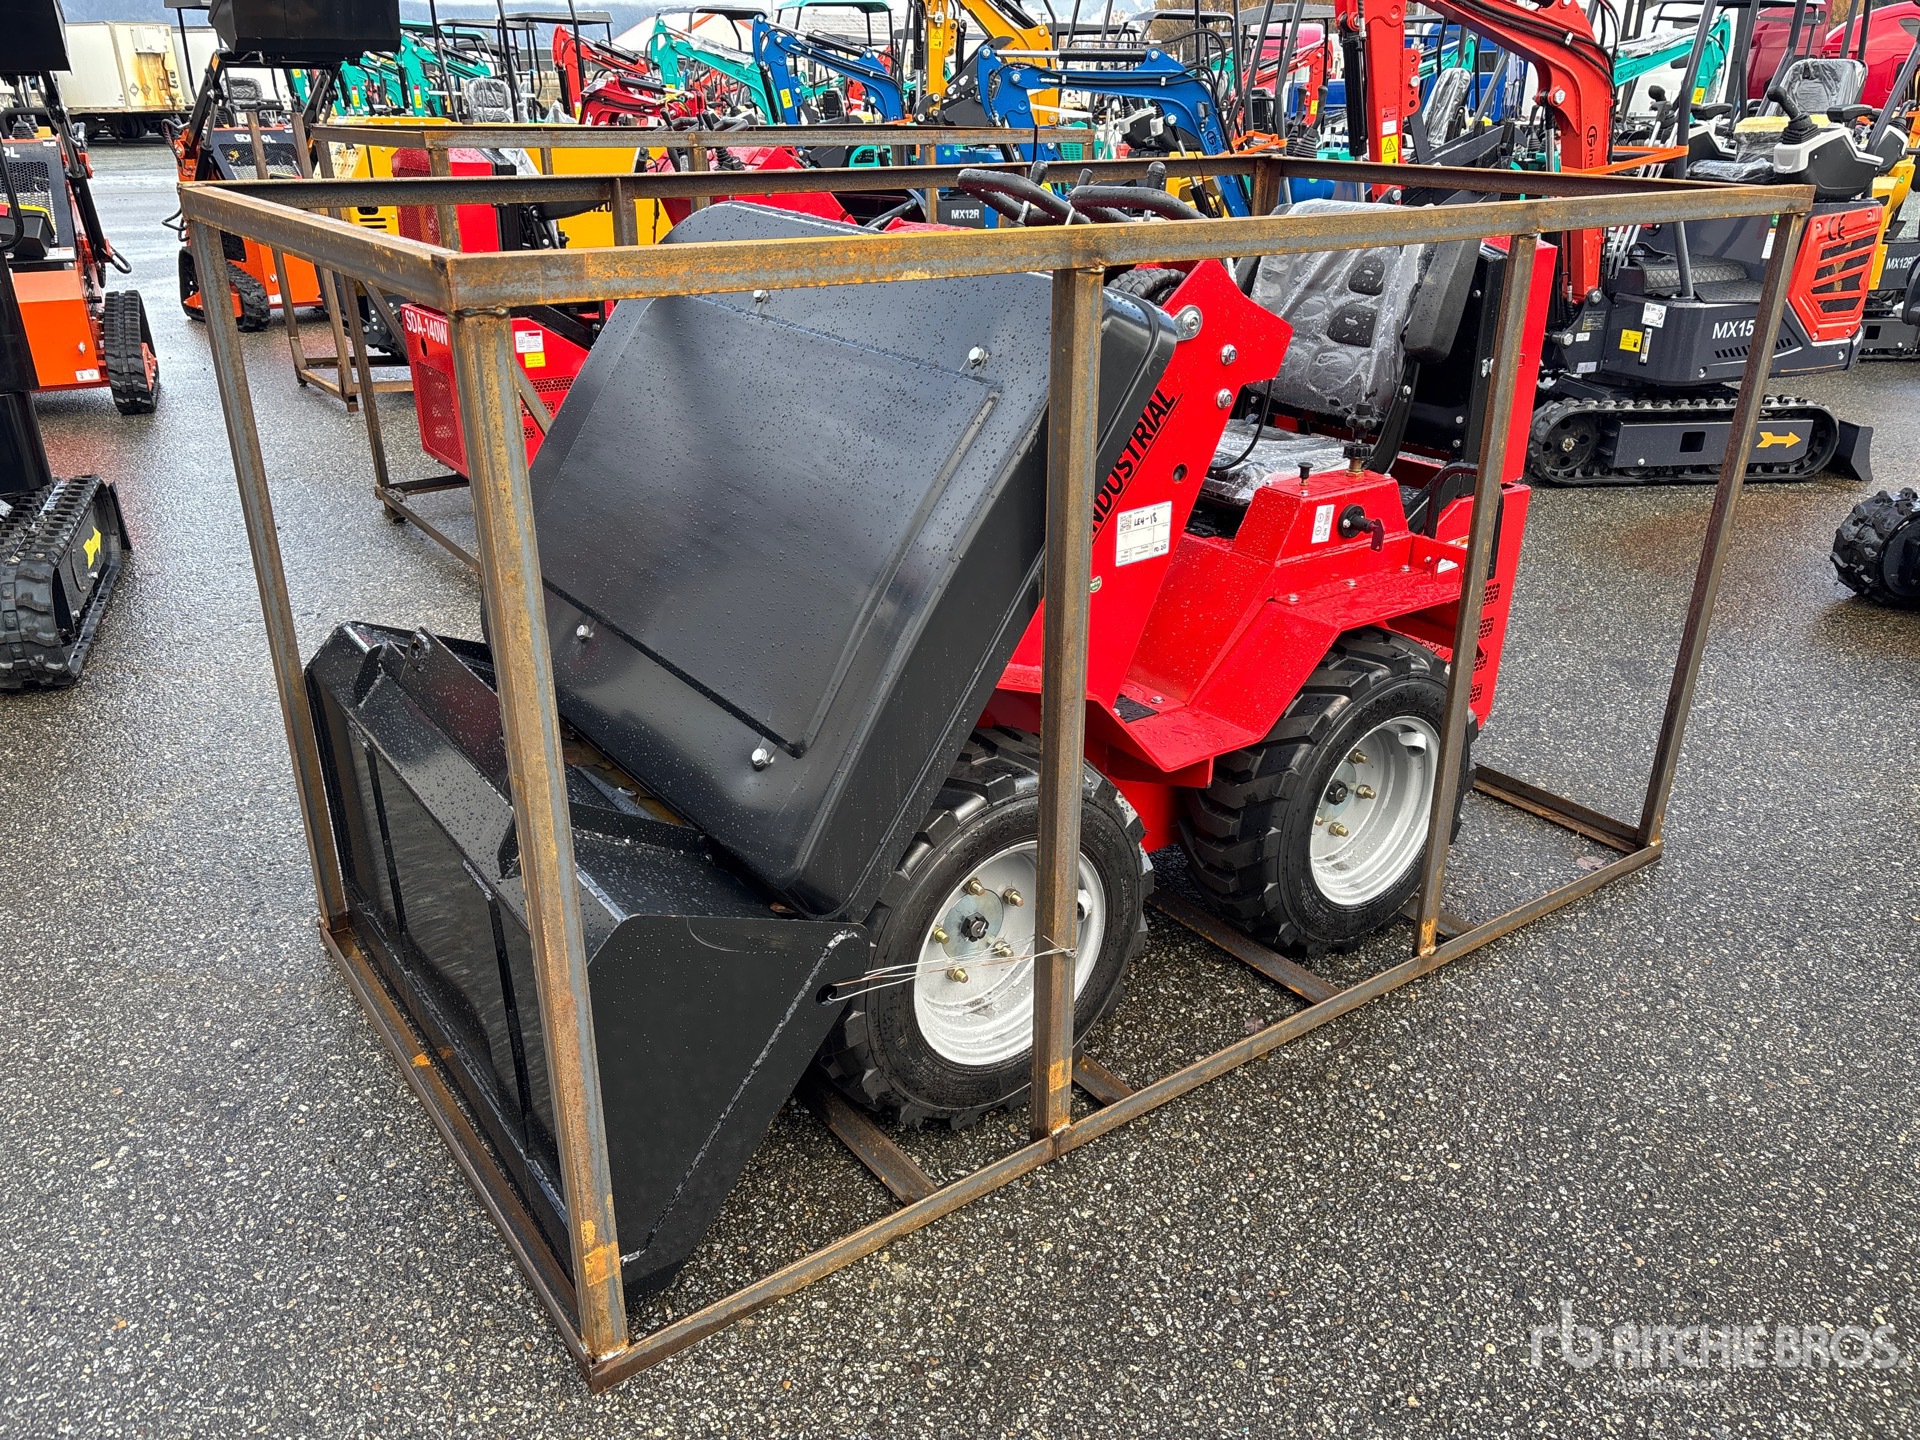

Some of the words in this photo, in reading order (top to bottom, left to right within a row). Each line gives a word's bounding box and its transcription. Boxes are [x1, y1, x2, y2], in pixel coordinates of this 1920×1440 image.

[951, 209, 980, 219] MX12R
[405, 309, 448, 346] SDA-140W
[1712, 319, 1755, 339] MX15
[1091, 388, 1176, 533] NDUSTRIAL
